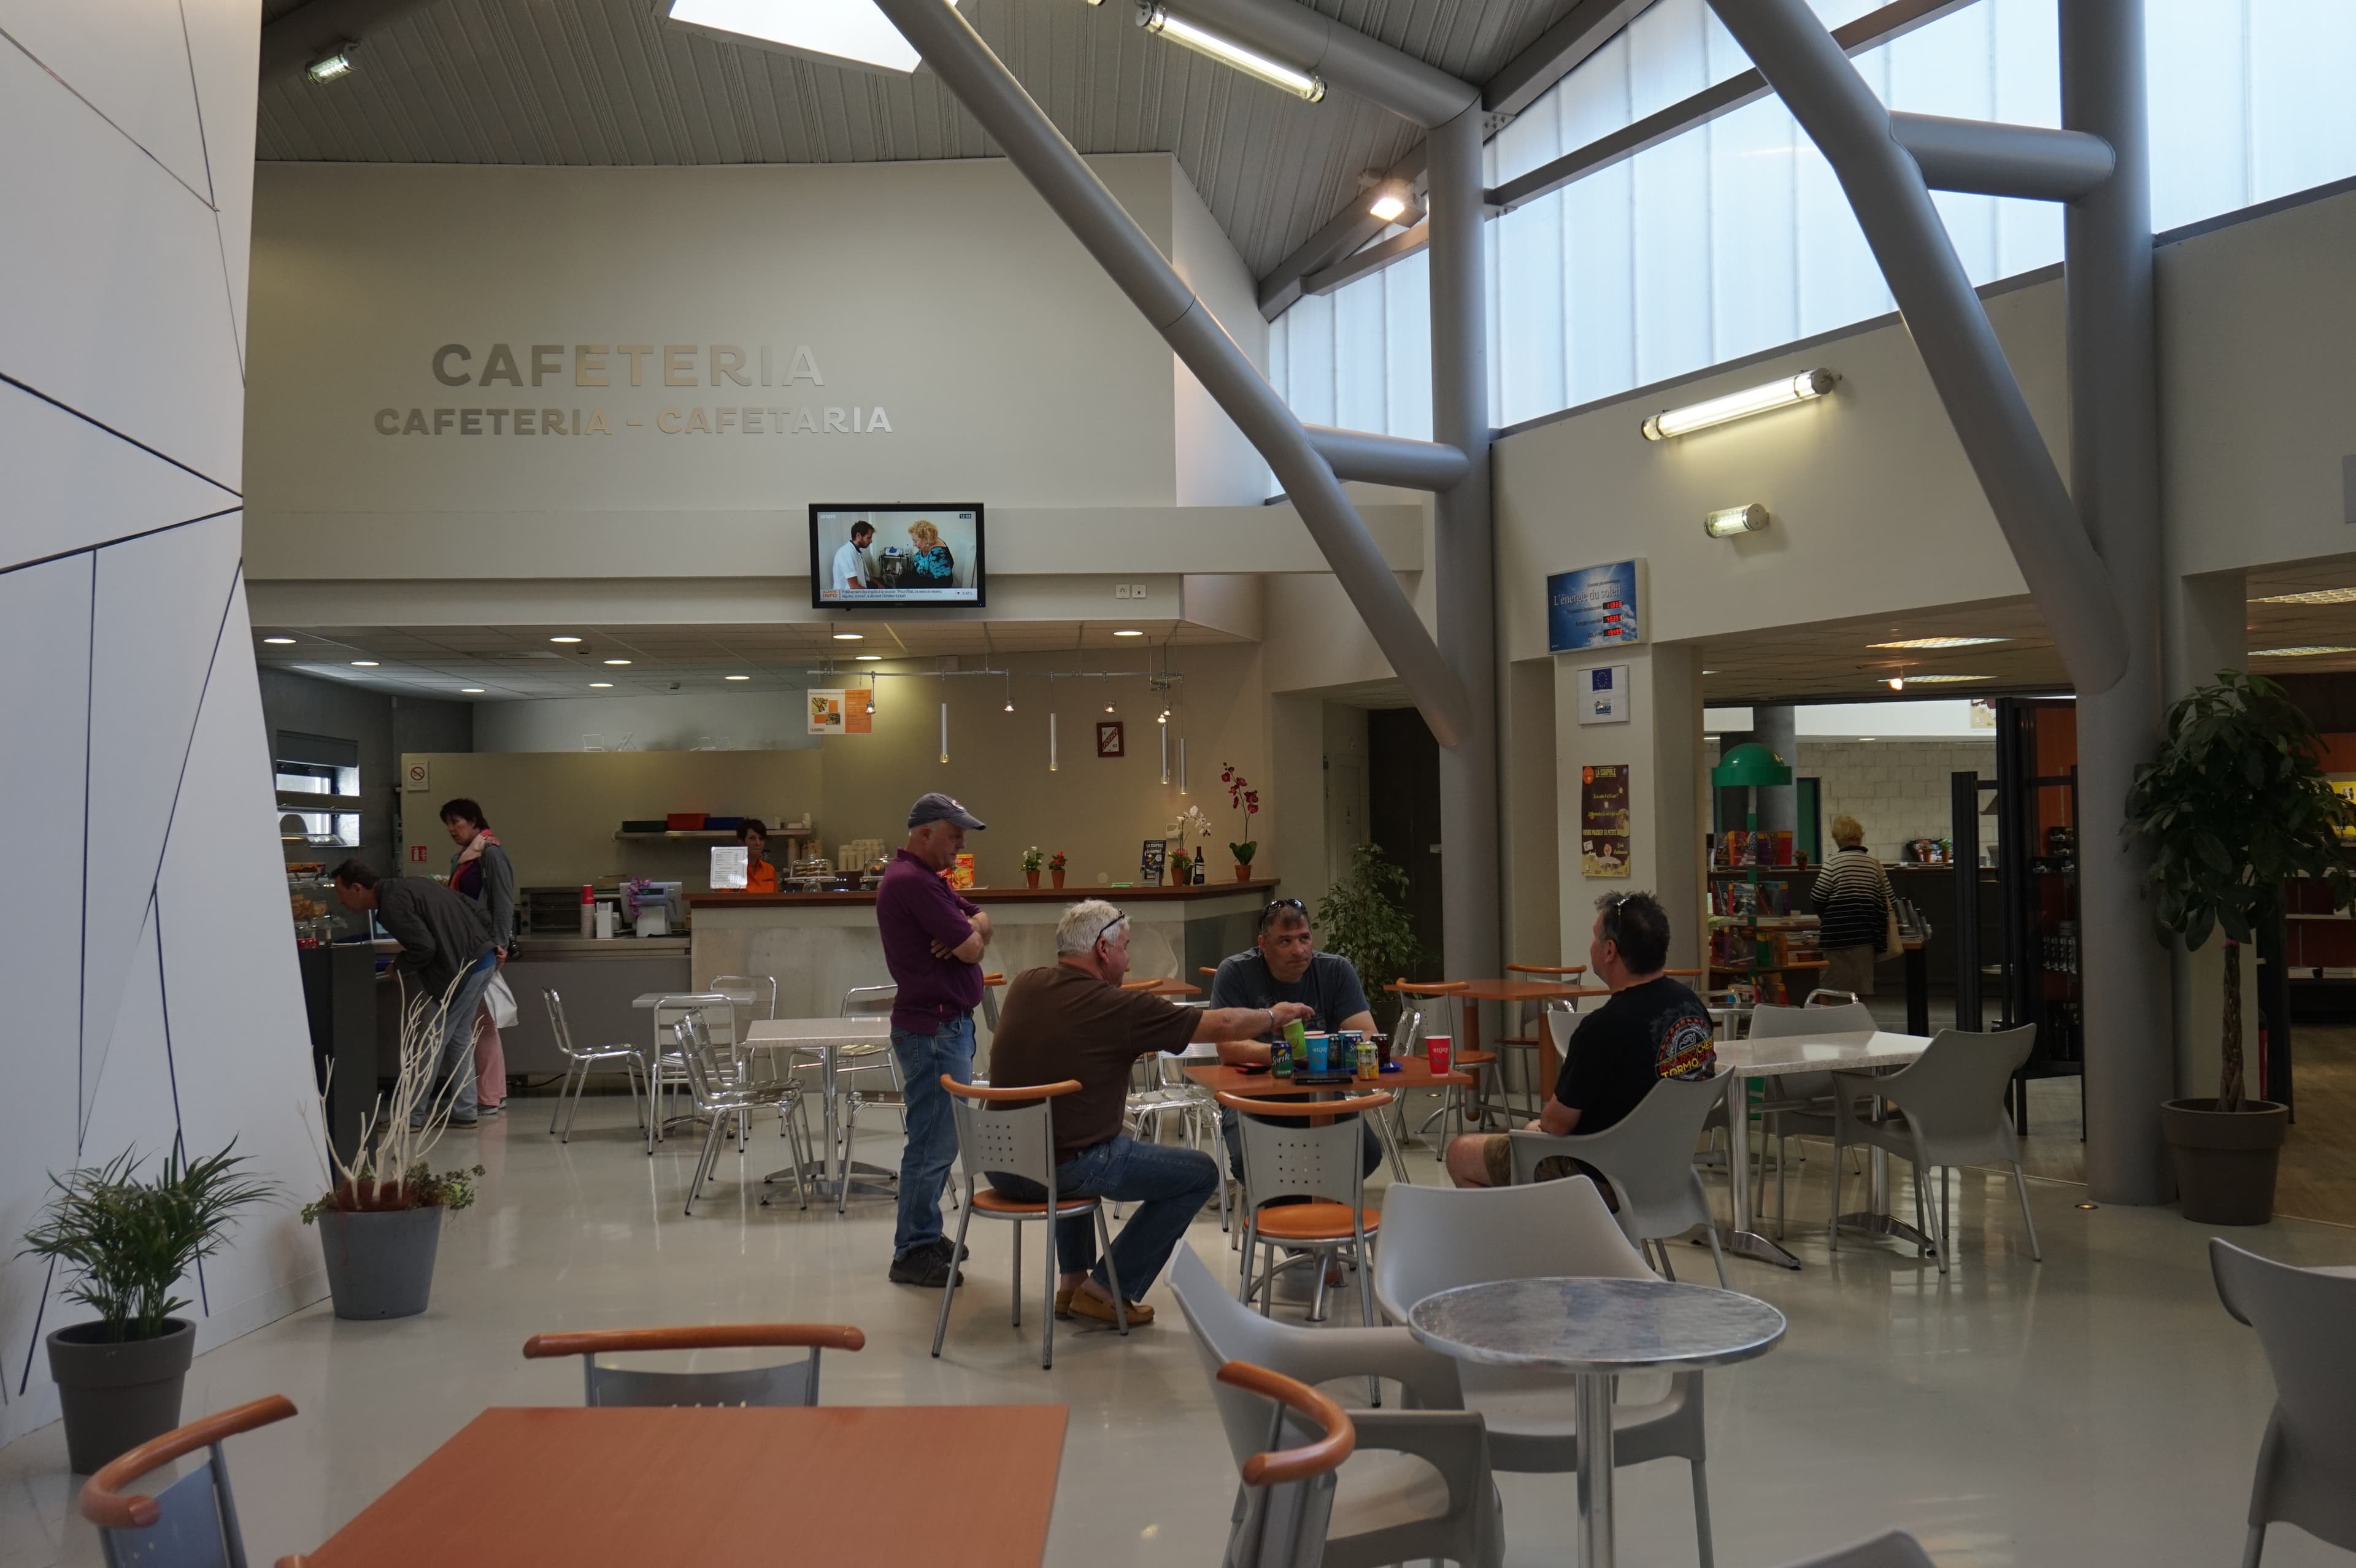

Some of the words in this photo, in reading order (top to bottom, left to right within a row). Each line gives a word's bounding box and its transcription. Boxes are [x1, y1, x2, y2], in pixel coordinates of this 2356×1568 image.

[432, 343, 825, 387] CAFETERIA
[374, 408, 613, 435] CAFETERIA
[656, 406, 893, 434] CAFETARIA
[1553, 592, 1588, 606] L'énergie
[1589, 589, 1600, 601] du
[1601, 584, 1621, 599] soleil
[1272, 1053, 1291, 1066] Sprite
[1660, 1058, 1698, 1077] TORMO
